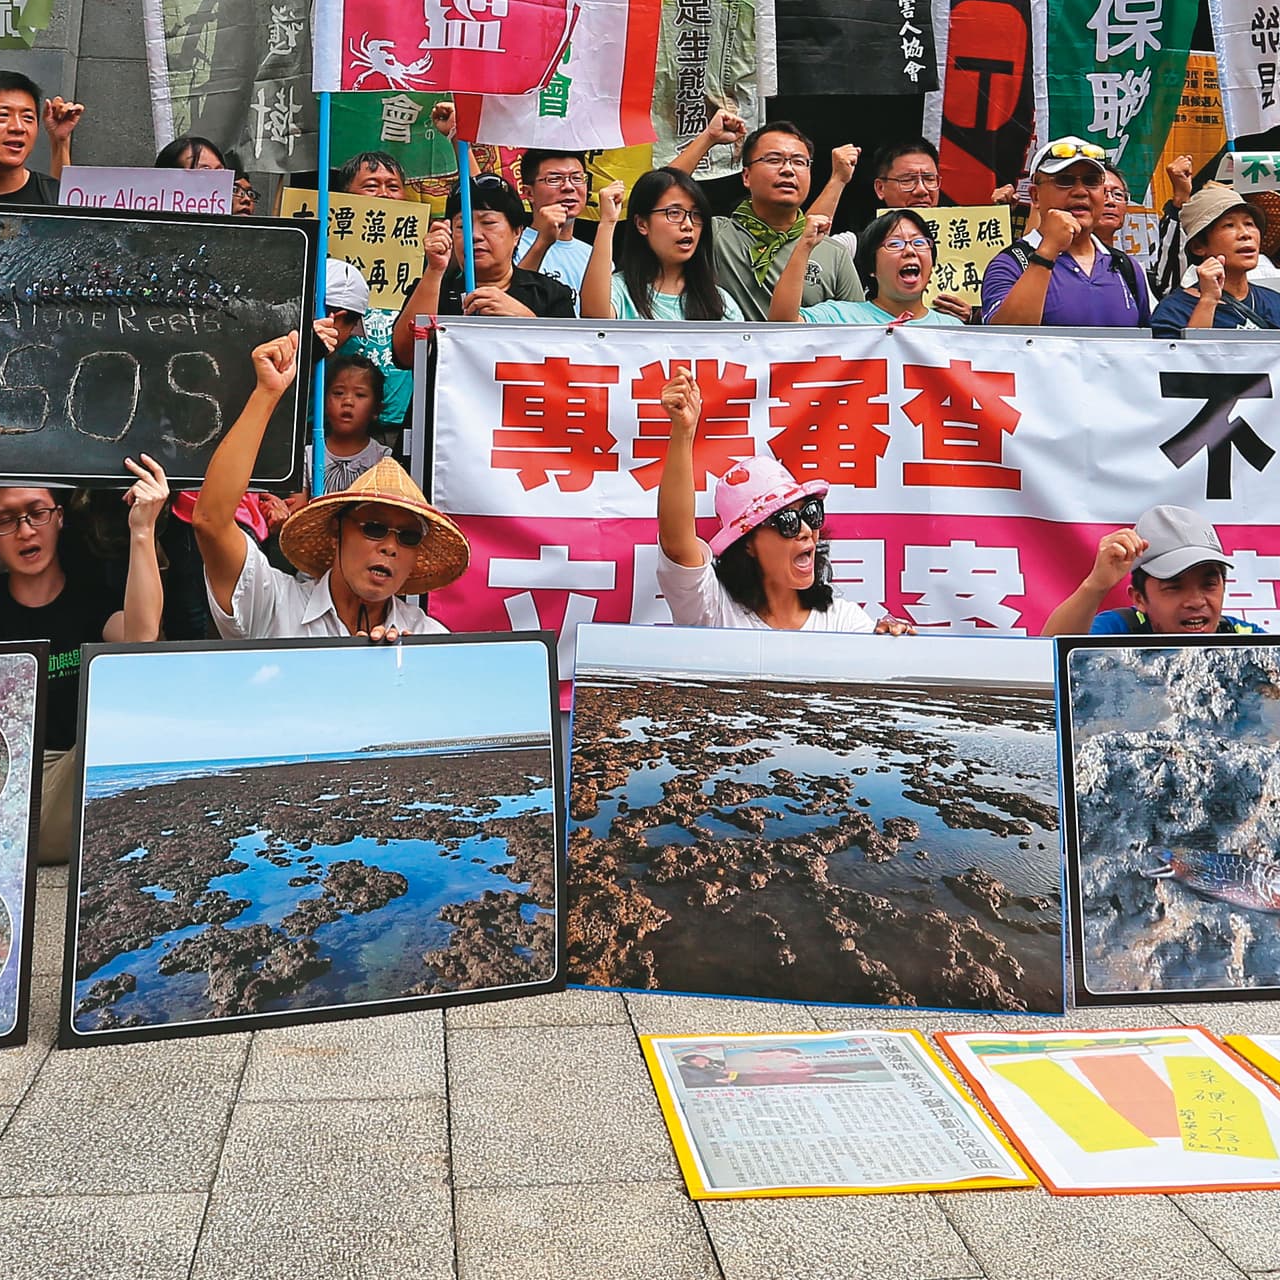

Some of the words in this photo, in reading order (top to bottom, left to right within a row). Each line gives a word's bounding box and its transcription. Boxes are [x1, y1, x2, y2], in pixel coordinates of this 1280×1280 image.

[67, 186, 107, 209] Our
[114, 188, 165, 213] Algal
[172, 192, 227, 216] Reefs
[490, 355, 1022, 493] 專業審查
